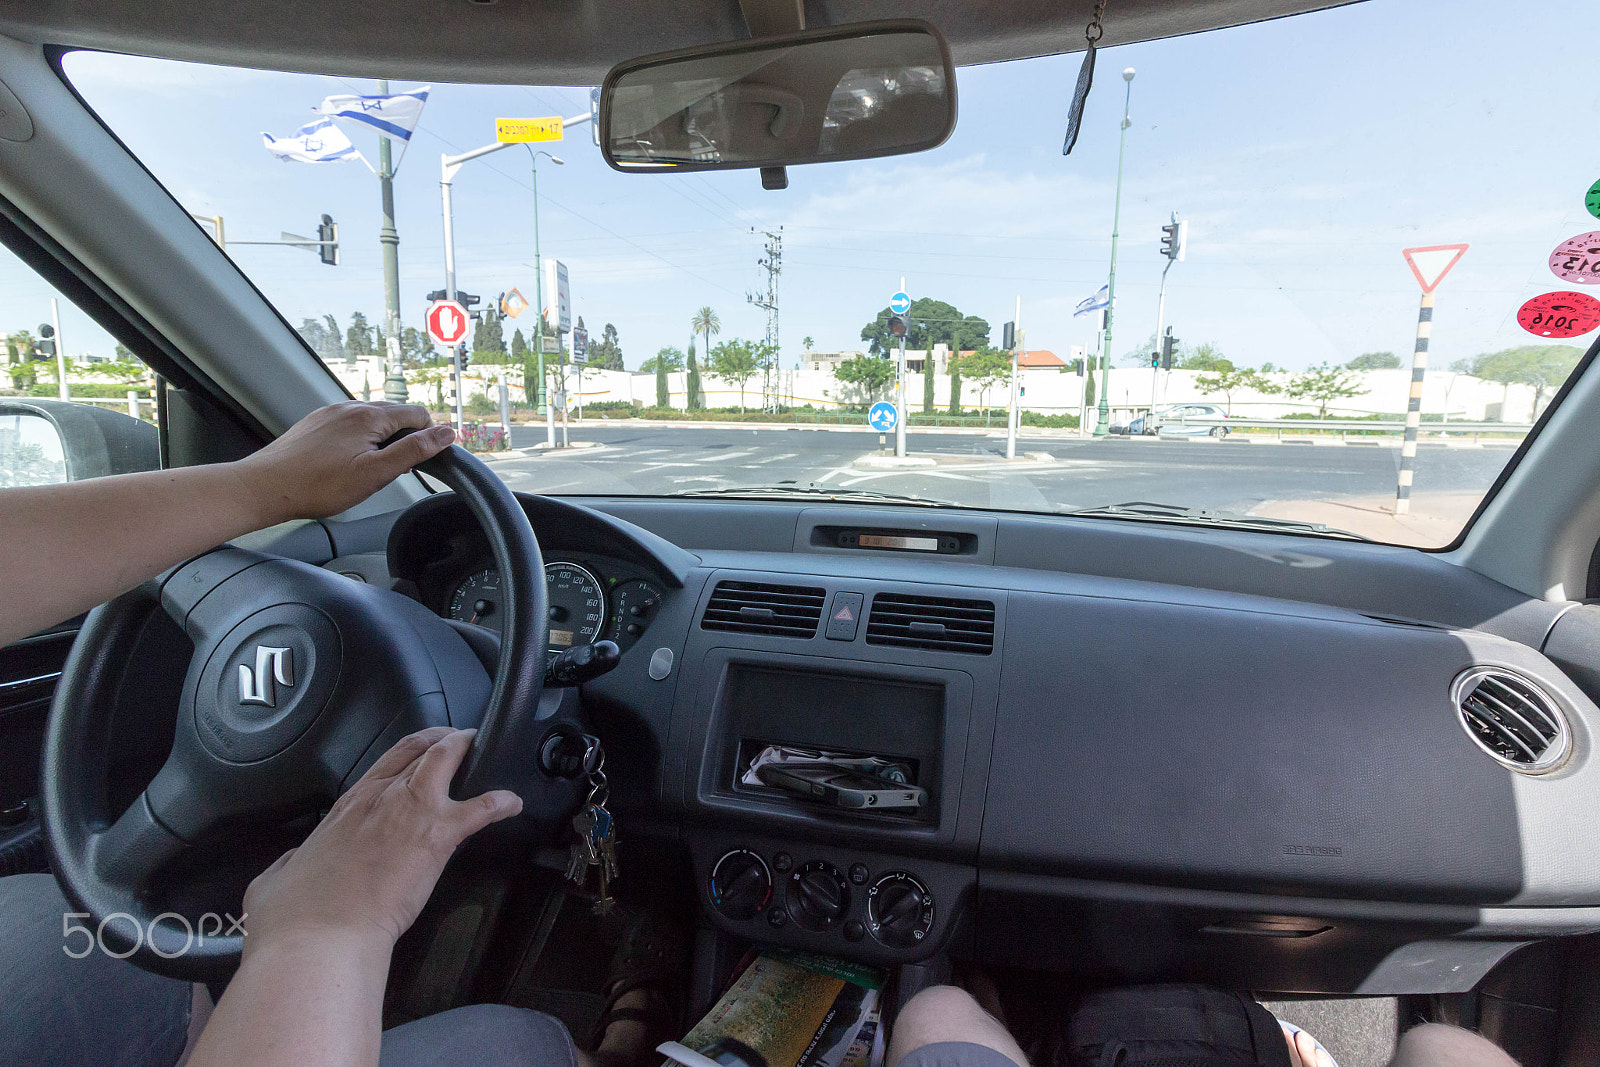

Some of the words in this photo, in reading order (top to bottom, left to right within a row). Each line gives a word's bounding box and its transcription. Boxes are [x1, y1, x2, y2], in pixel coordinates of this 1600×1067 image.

[550, 123, 559, 134] 17
[586, 598, 598, 607] 160
[586, 613, 599, 621] 180
[580, 626, 593, 634] 200
